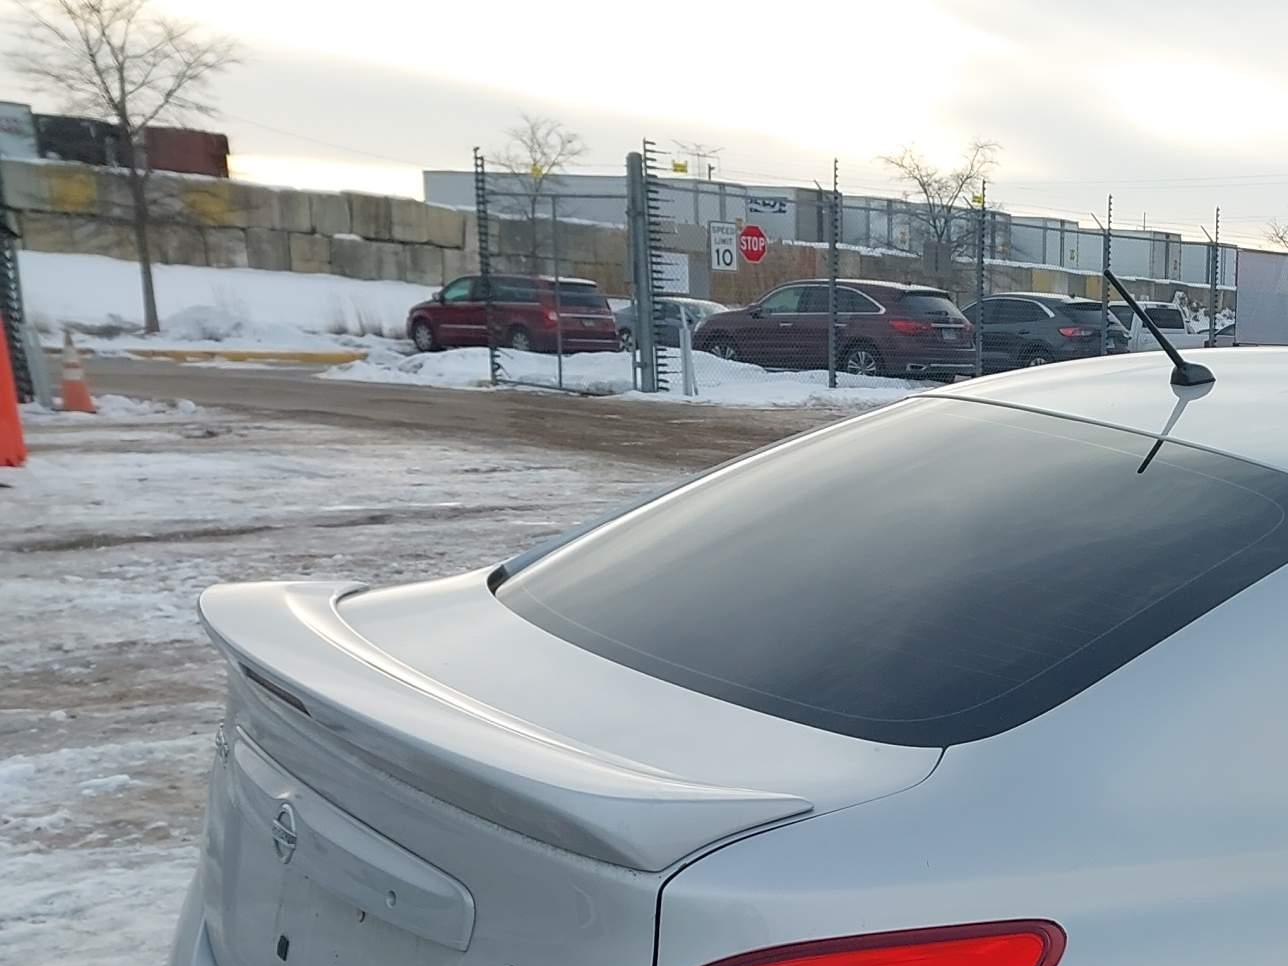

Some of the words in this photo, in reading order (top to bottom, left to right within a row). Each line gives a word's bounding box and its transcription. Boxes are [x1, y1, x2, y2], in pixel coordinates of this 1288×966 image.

[712, 226, 736, 235] SPEED
[715, 237, 733, 246] LIMIT
[741, 236, 765, 252] STOP
[715, 248, 733, 266] 10
